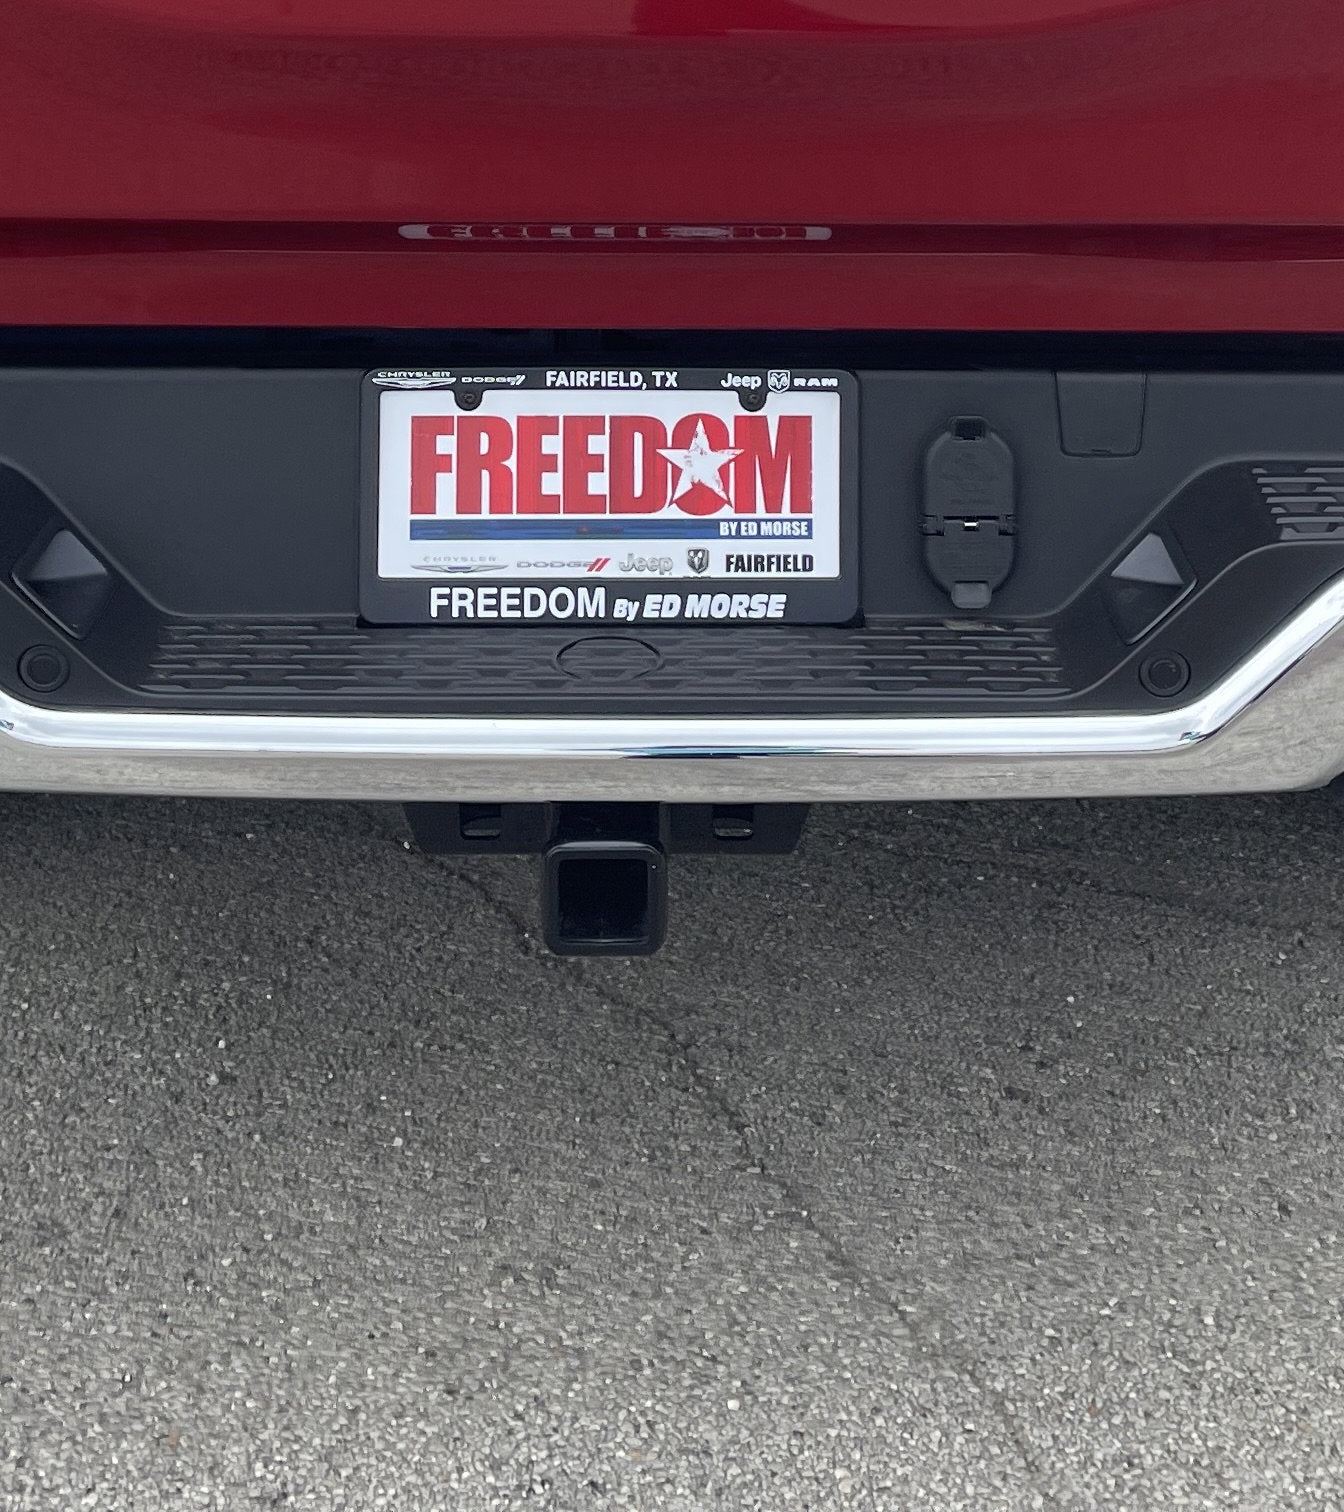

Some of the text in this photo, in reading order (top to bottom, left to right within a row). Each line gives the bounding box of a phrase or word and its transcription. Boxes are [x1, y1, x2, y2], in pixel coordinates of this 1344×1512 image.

[545, 370, 678, 390] FAIRFIELD, TX
[720, 373, 762, 389] Jeep
[793, 377, 838, 387] RAM
[410, 413, 813, 516] FREEDOM
[719, 521, 809, 536] BY ED MORSE
[618, 553, 673, 575] Jeep
[725, 554, 814, 573] FAIRFIELD
[429, 586, 788, 621] FREEDOM By ED MORSE
